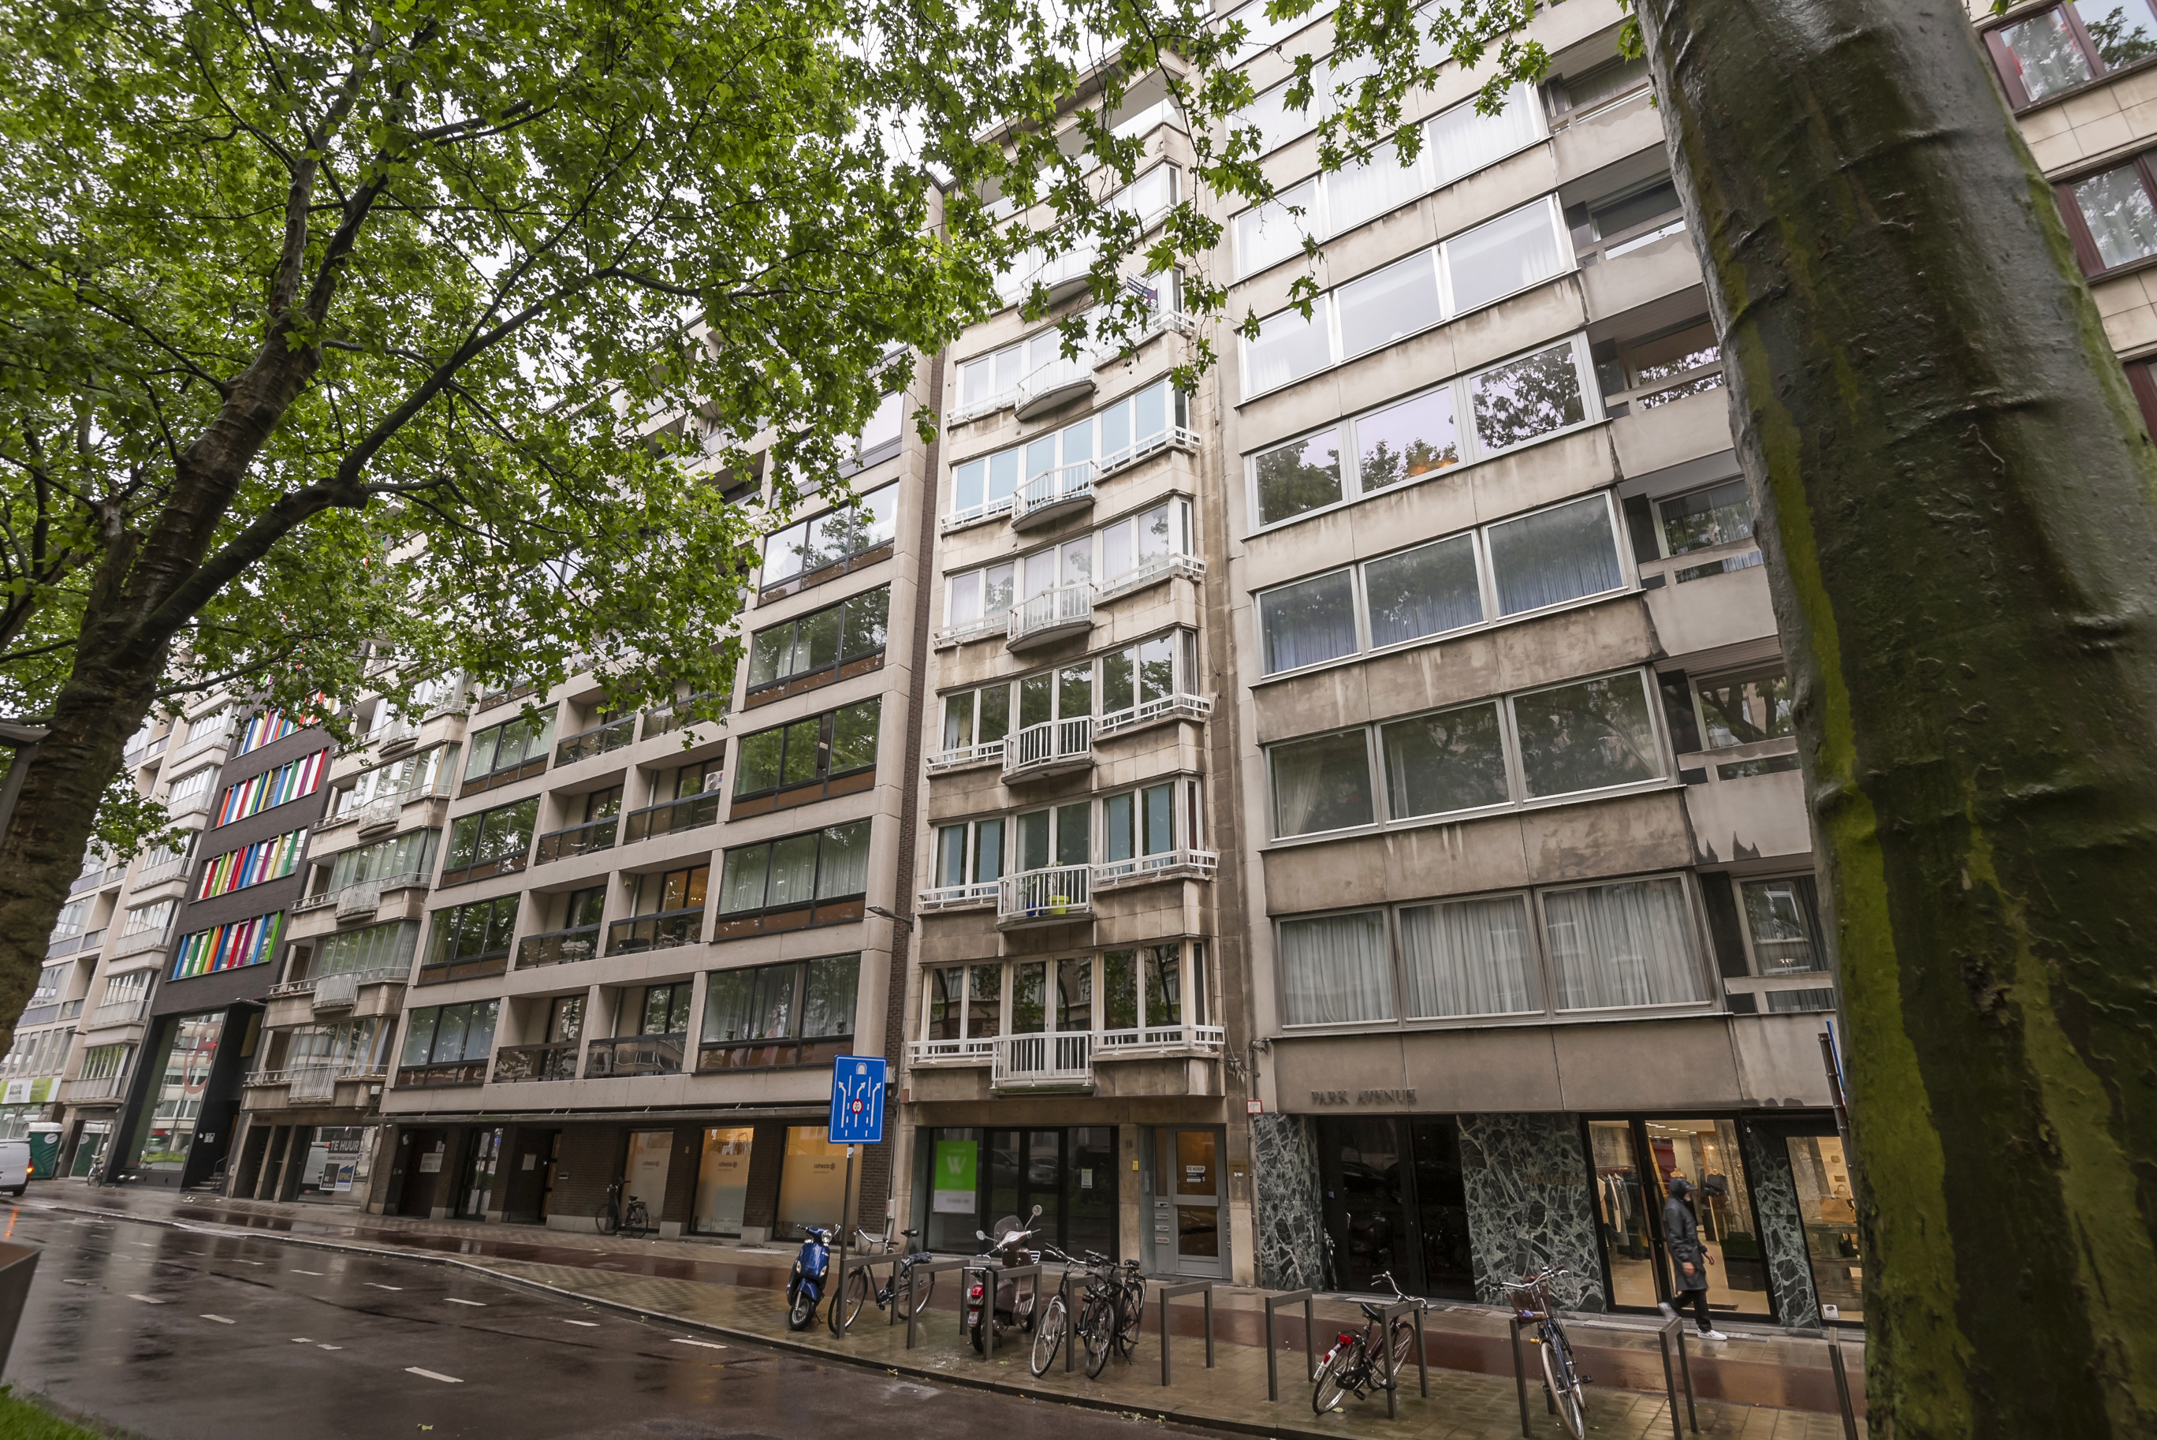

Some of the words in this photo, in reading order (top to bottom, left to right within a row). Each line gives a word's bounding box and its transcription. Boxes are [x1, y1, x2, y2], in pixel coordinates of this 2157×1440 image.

[1311, 1090, 1349, 1105] PARK
[1357, 1089, 1417, 1105] AVENUE
[330, 1140, 340, 1151] TE
[340, 1140, 360, 1151] HUUR
